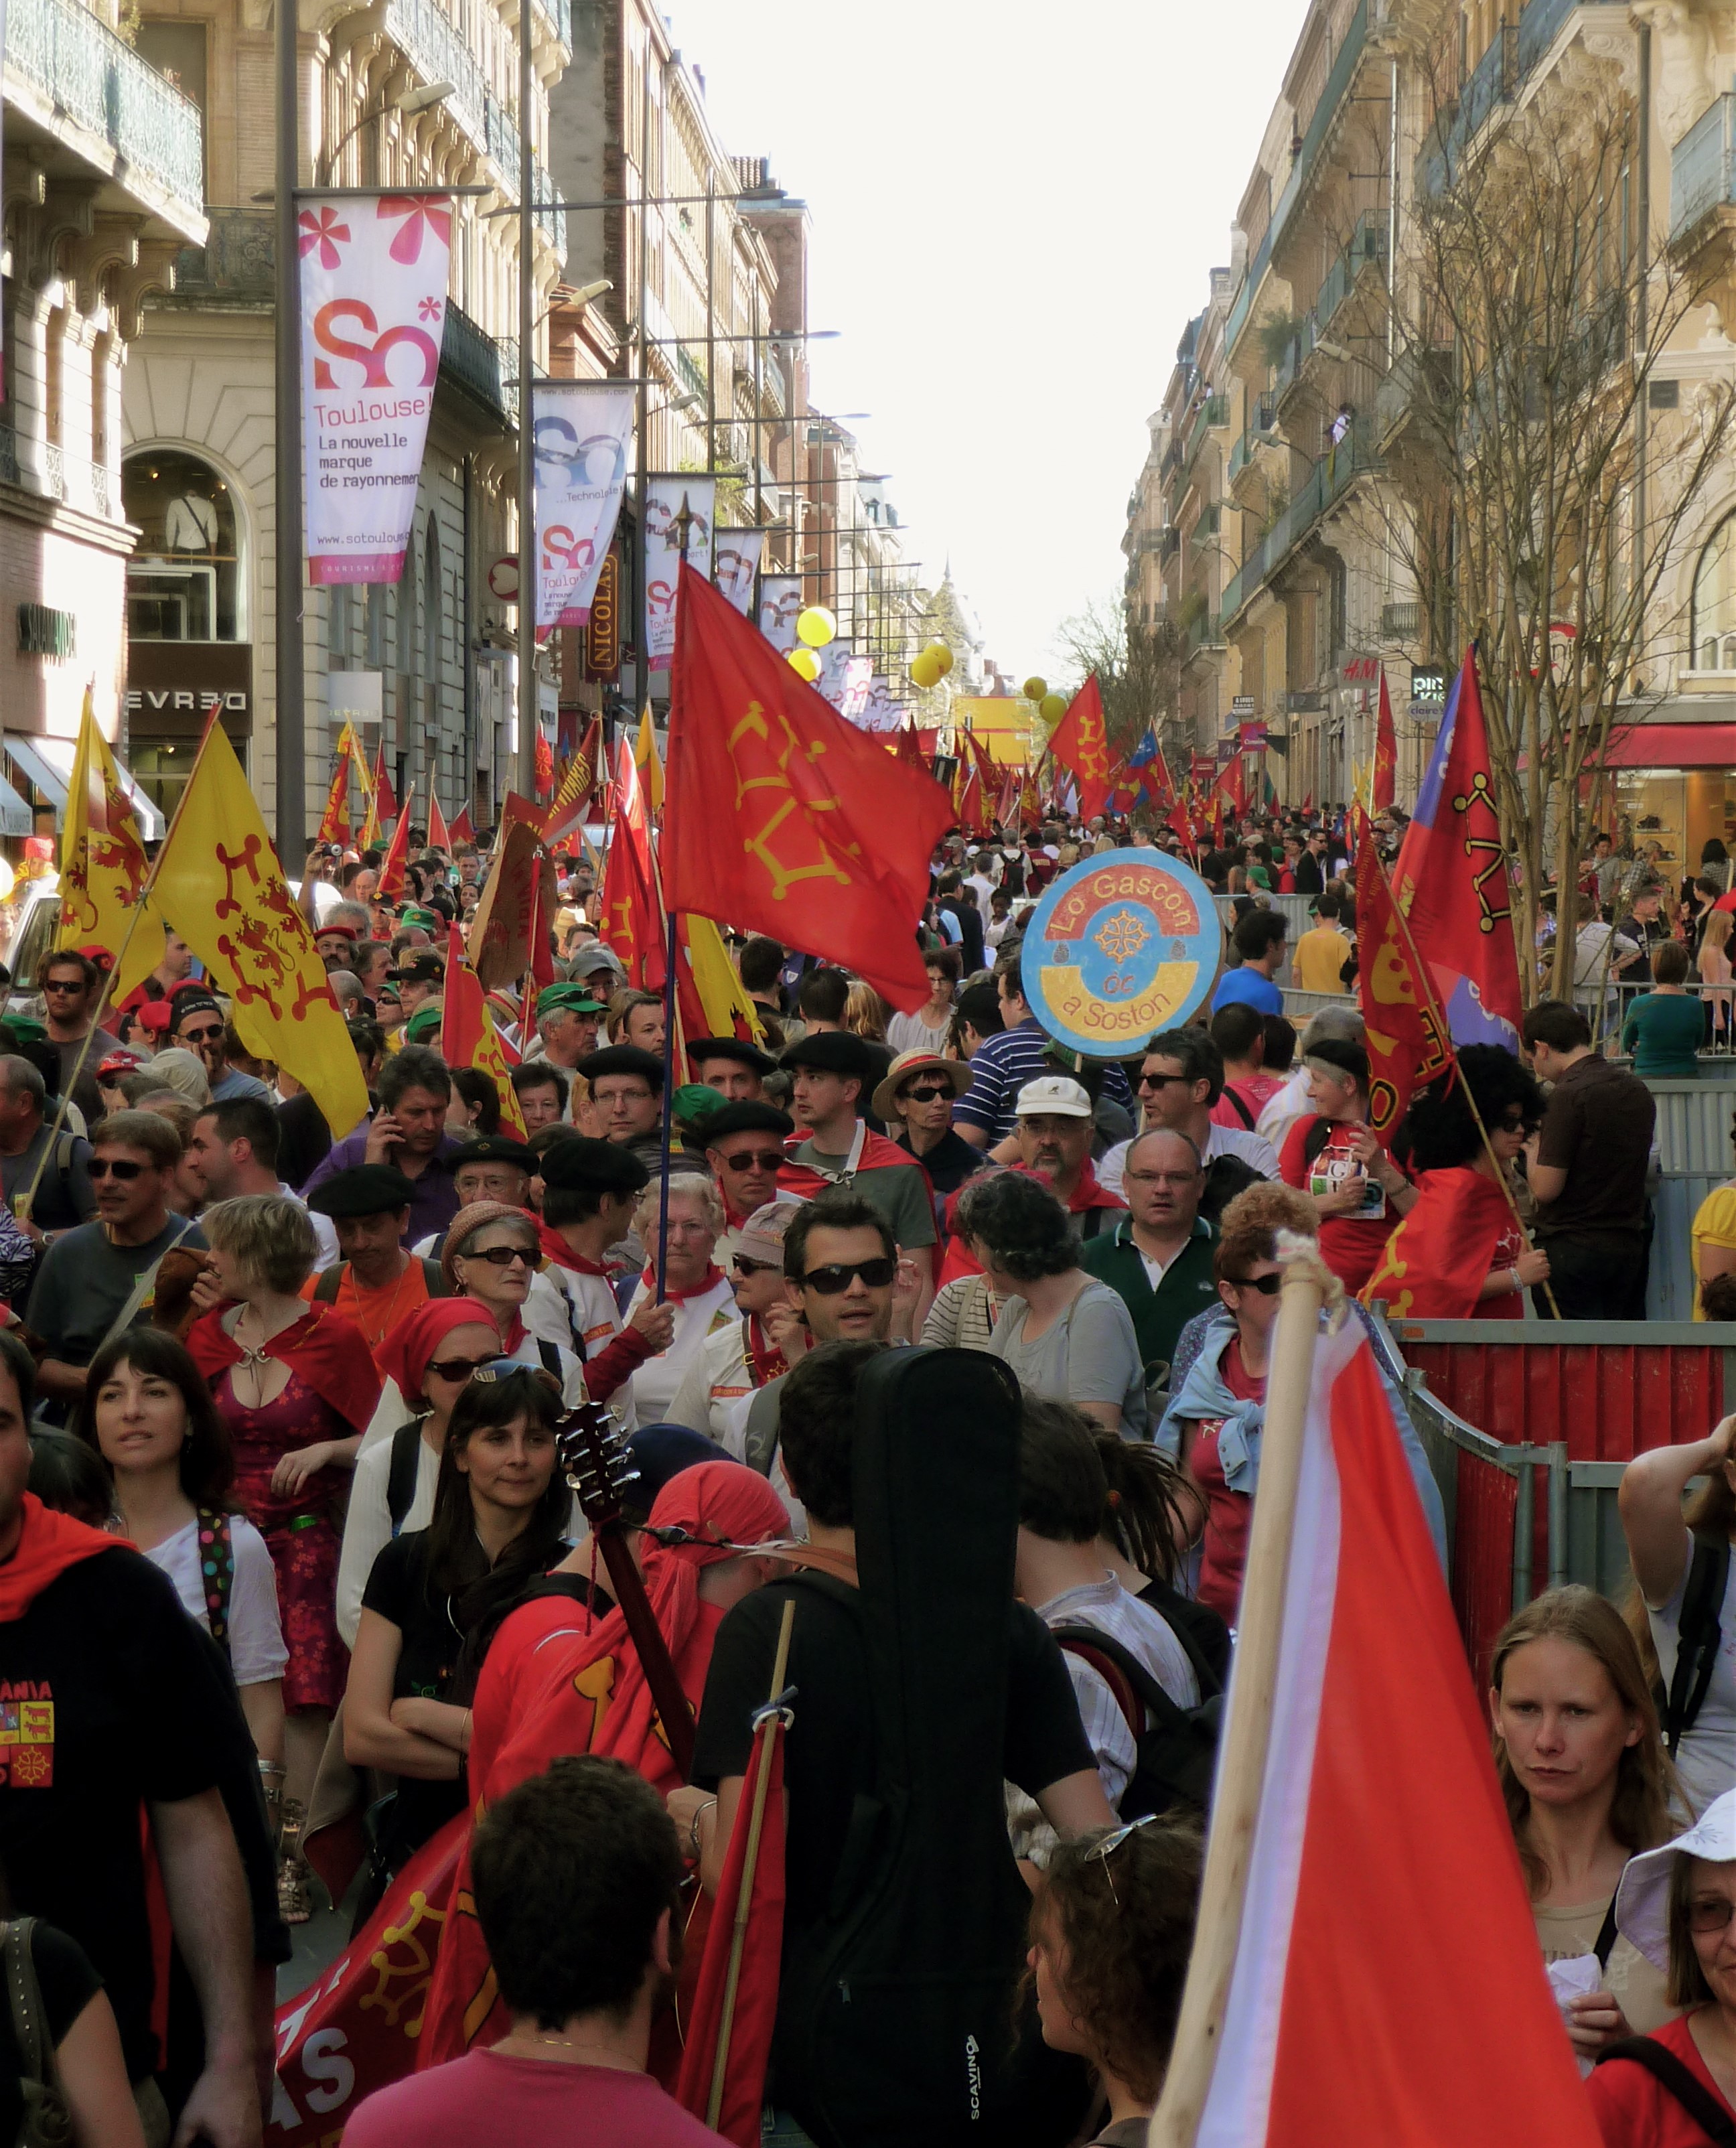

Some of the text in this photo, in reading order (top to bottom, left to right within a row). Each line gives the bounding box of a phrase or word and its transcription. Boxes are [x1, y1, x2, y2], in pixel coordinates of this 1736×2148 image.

[313, 298, 439, 390] So
[319, 433, 408, 449] La nouvelle
[319, 457, 373, 471] marque
[319, 474, 338, 488] de
[595, 561, 611, 662] NICOLAS
[1344, 658, 1379, 682] H&M
[1050, 874, 1191, 933] Lo Gascon
[1062, 992, 1171, 1031] a Soston
